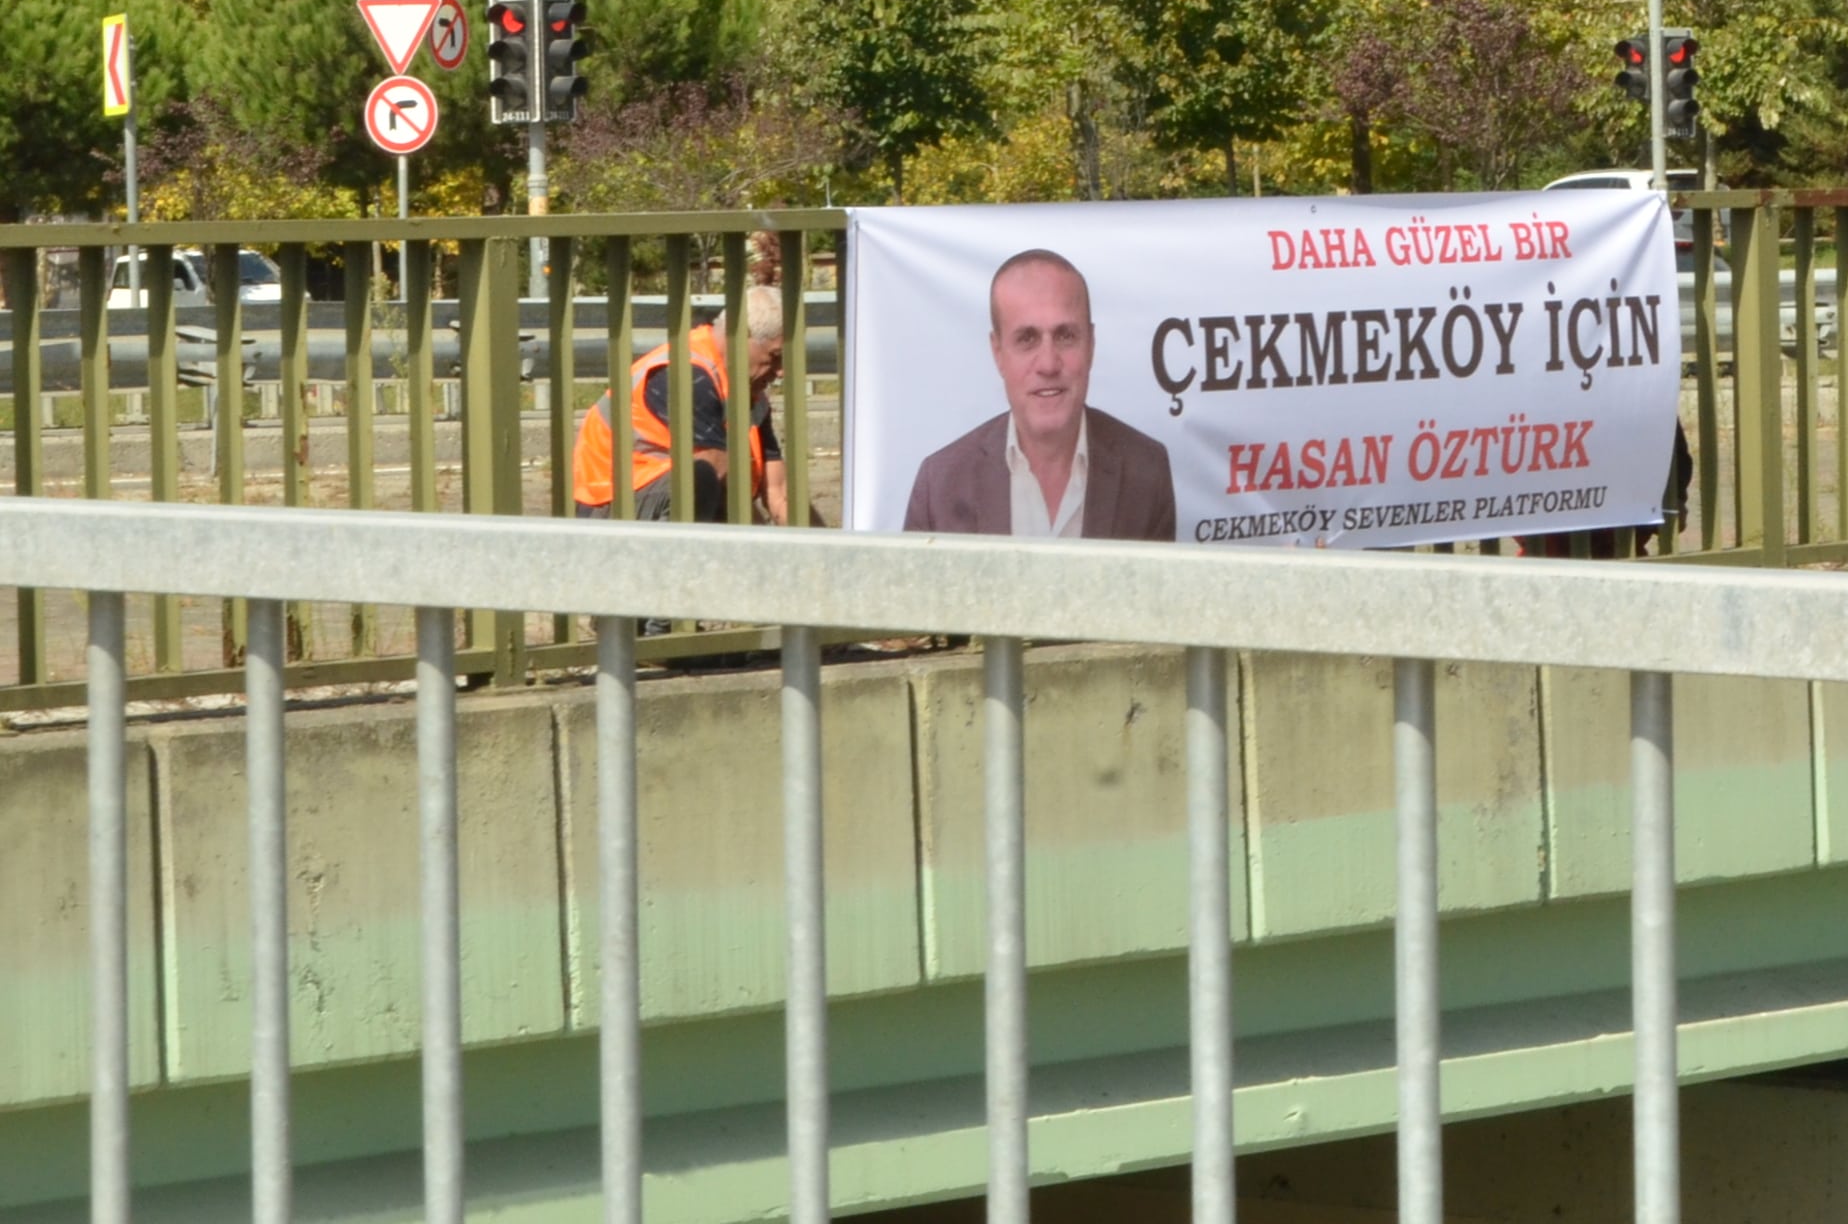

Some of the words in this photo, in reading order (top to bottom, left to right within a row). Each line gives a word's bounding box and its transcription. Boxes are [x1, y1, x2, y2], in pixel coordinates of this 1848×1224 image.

[1268, 224, 1376, 270] DAHA
[1384, 216, 1503, 265] GÜZEL
[1509, 212, 1573, 260] BİR
[1151, 286, 1524, 416] ÇEKMEKÖY
[1544, 277, 1662, 390] İÇİN
[1226, 435, 1393, 495] HASAN
[1407, 413, 1594, 482] ÖZTÜRK
[1342, 499, 1467, 530] SEVENLER
[1472, 486, 1608, 519] PLATFORMU
